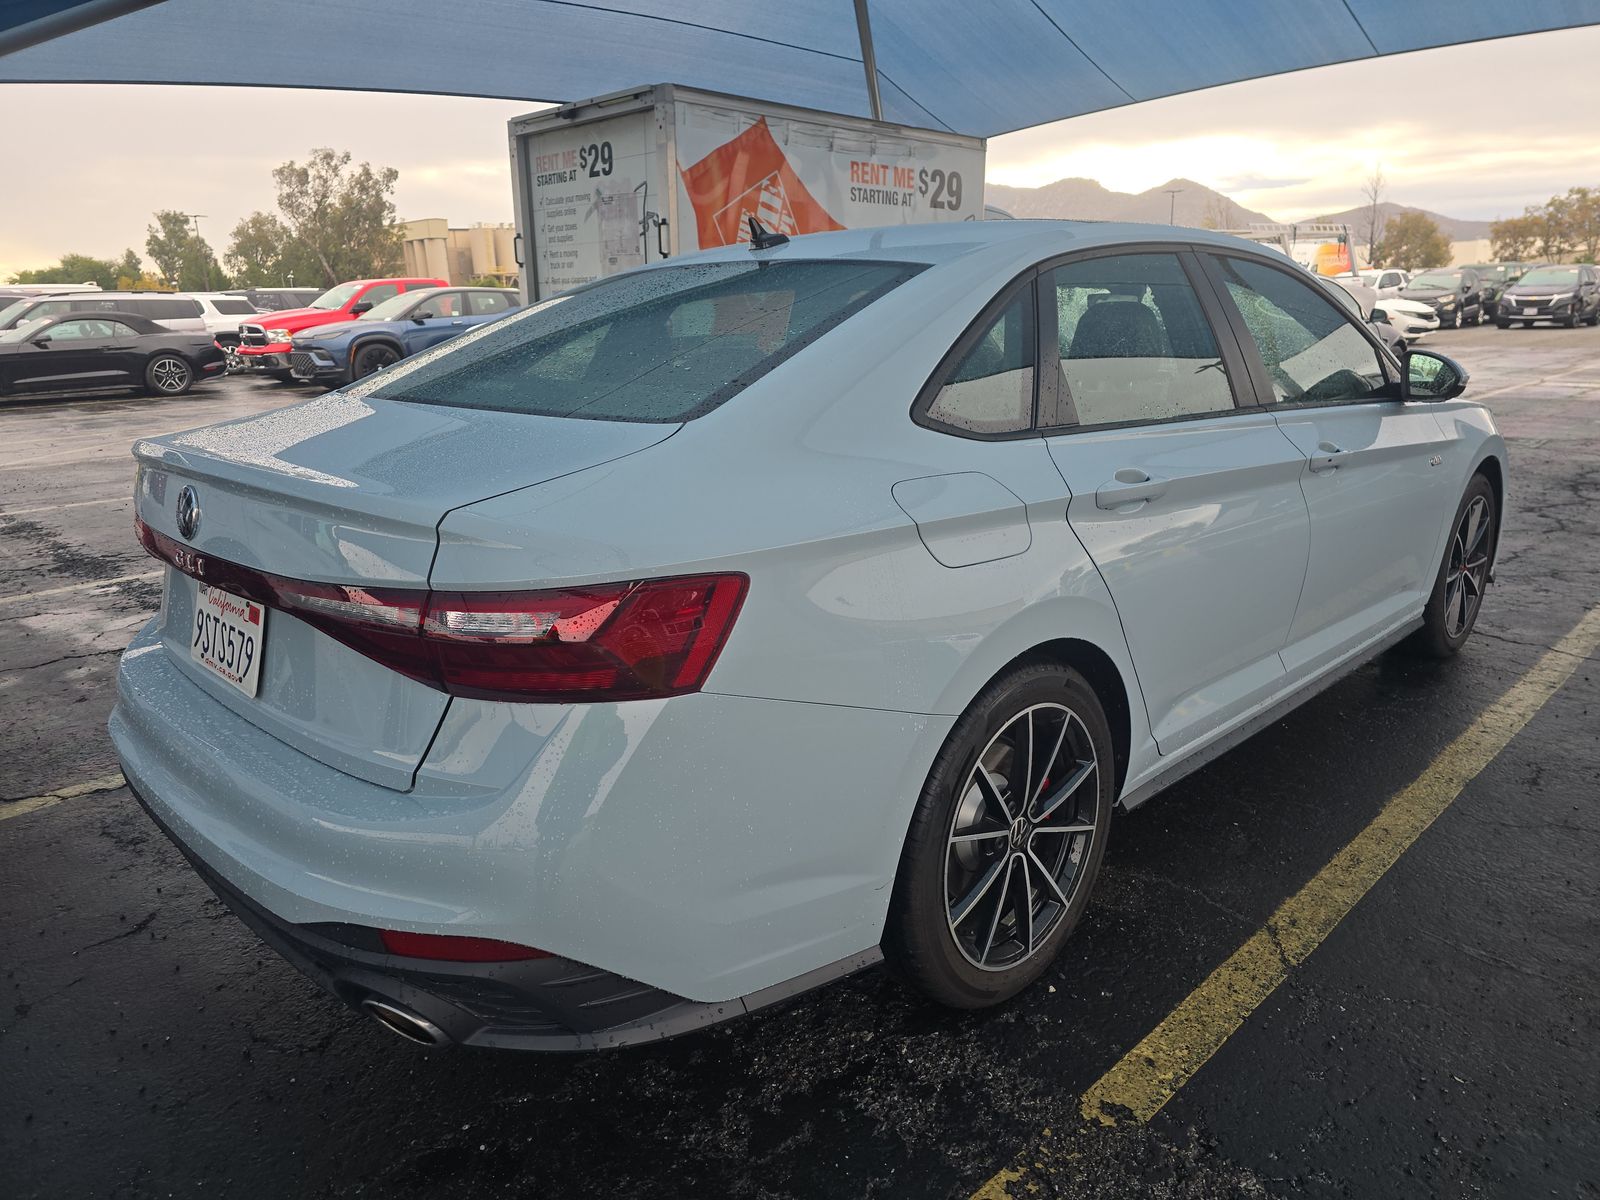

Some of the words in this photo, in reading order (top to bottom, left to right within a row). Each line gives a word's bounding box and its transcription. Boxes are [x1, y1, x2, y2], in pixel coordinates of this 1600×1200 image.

[535, 153, 560, 173] RENT
[562, 149, 577, 169] ME
[579, 141, 613, 178] $29
[536, 171, 568, 187] STARTING
[568, 169, 577, 182] AT
[850, 160, 889, 186] RENT
[893, 165, 915, 189] ME
[918, 165, 962, 211] $29
[850, 186, 899, 206] STARTING
[901, 192, 913, 207] AT
[208, 585, 250, 622] California
[193, 608, 254, 678] 9STS579
[205, 657, 240, 683] dmv.ca.gov
